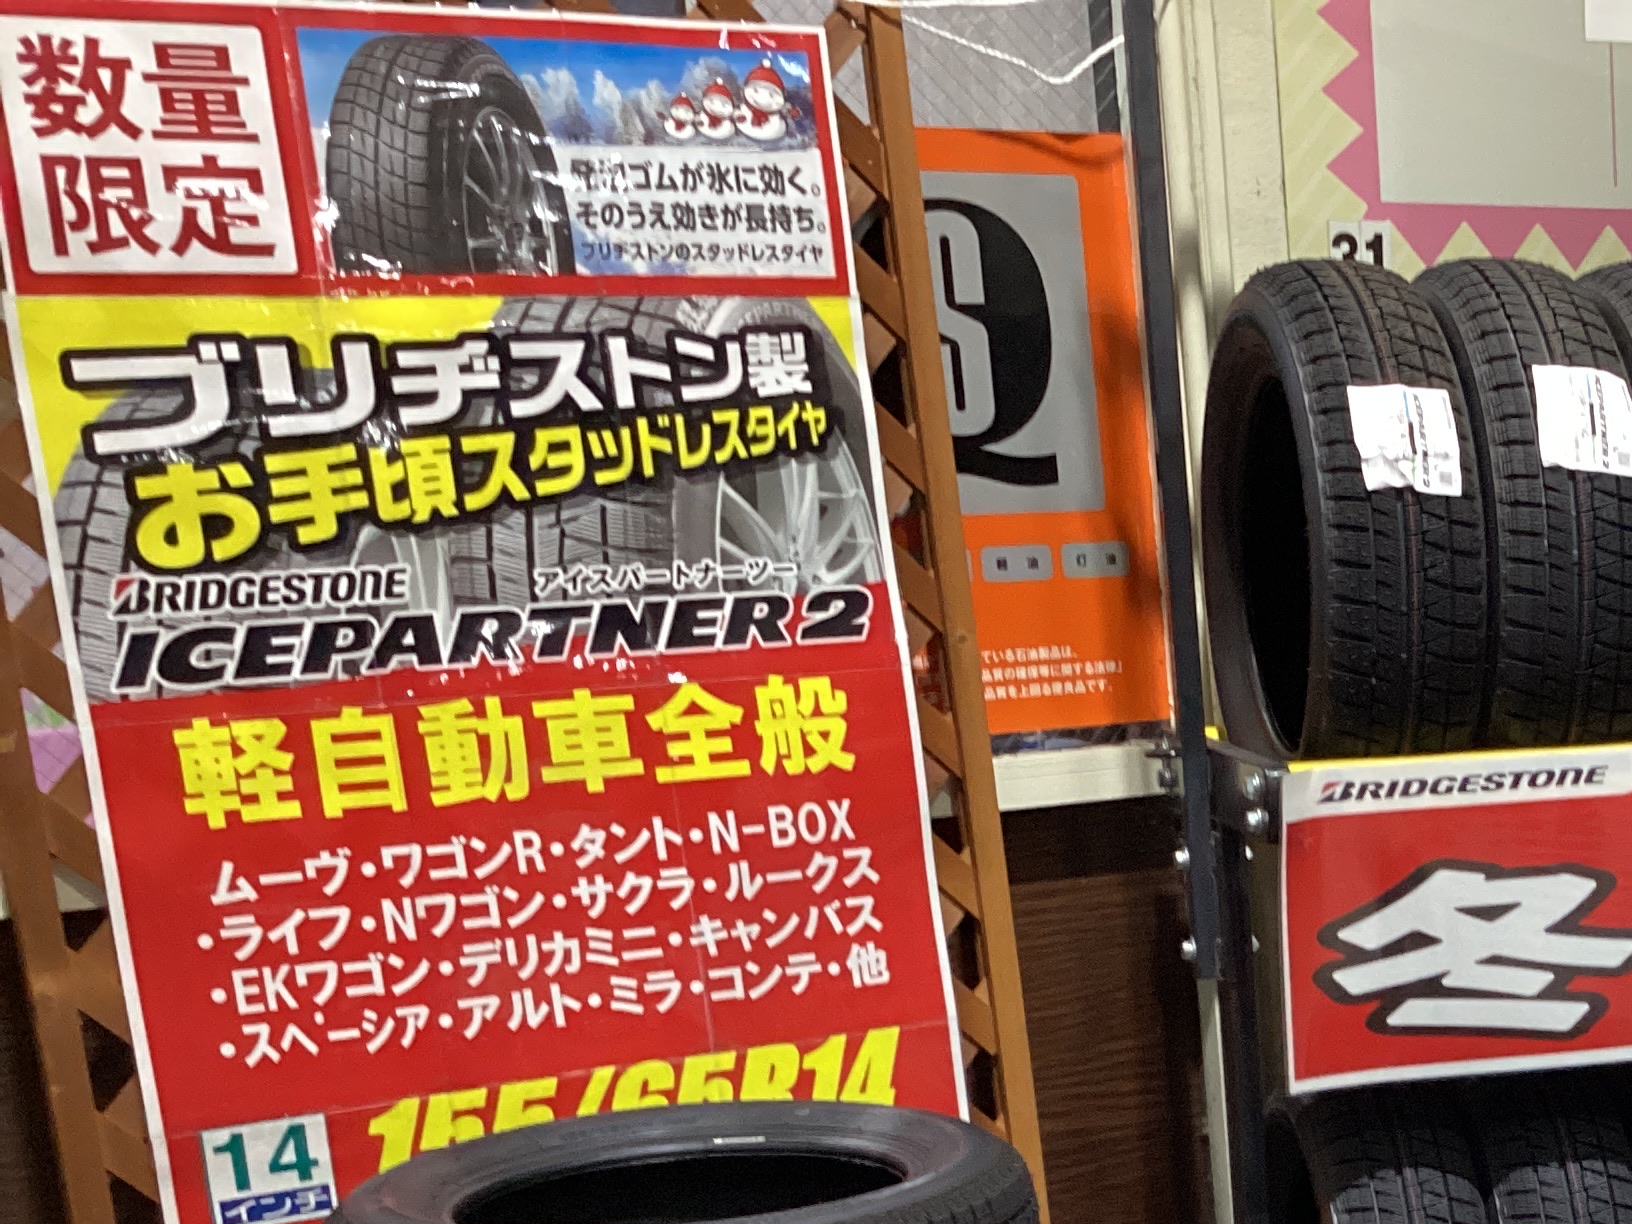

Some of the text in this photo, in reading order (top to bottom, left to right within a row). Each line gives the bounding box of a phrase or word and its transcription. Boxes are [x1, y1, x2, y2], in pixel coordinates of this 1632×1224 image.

[17, 33, 259, 144] 数量
[42, 154, 276, 260] 限定
[576, 201, 826, 234] そのうえ効きが長持ち。
[68, 331, 814, 458] ブリヂストン製
[134, 412, 828, 568] お手頃スタッドレスタイヤ
[112, 566, 406, 618] BRIDGESTONE
[172, 674, 858, 830] 軽自動車全般
[1318, 765, 1608, 803] BRIDGESTONE
[213, 1124, 319, 1192] 14
[224, 1188, 328, 1224] インチ
